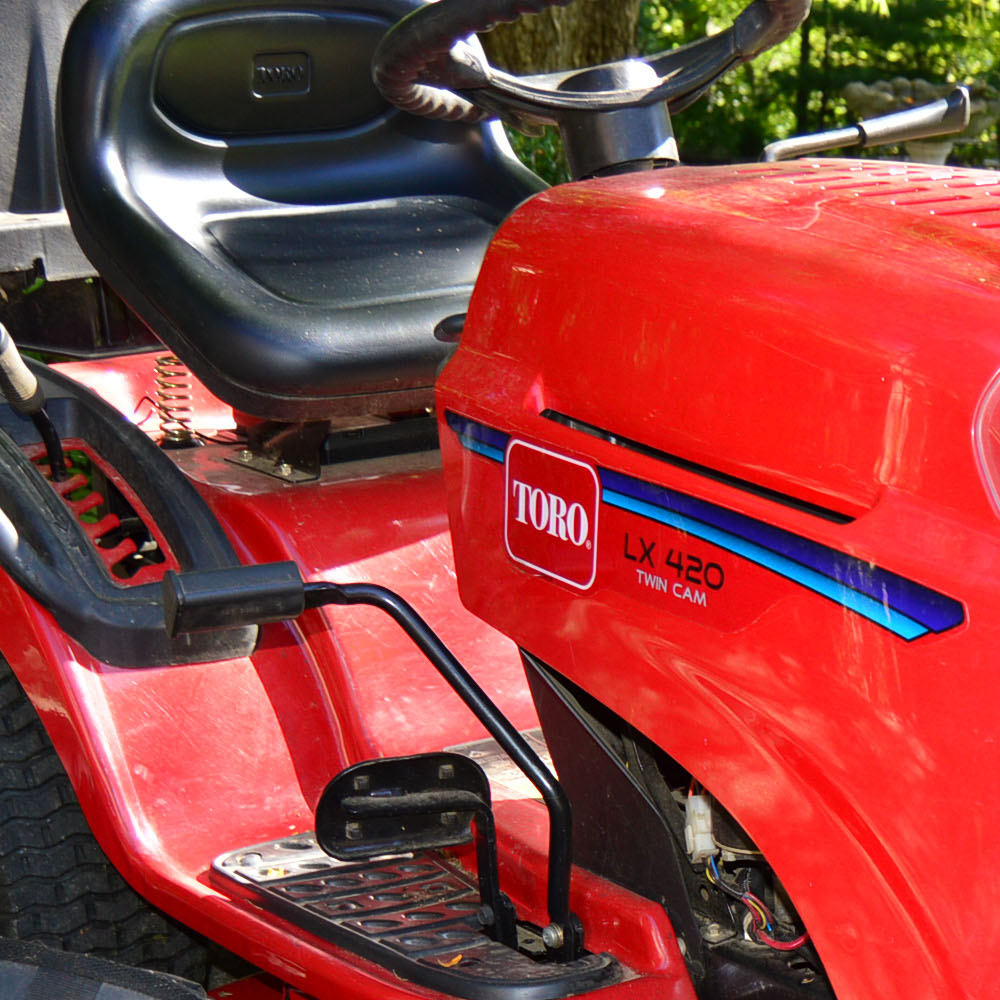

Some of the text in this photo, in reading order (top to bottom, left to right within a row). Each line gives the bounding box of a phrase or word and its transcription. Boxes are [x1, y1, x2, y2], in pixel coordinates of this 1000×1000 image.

[512, 479, 589, 547] TORO
[624, 532, 725, 590] LX 420
[636, 568, 708, 608] TWIN CAM
